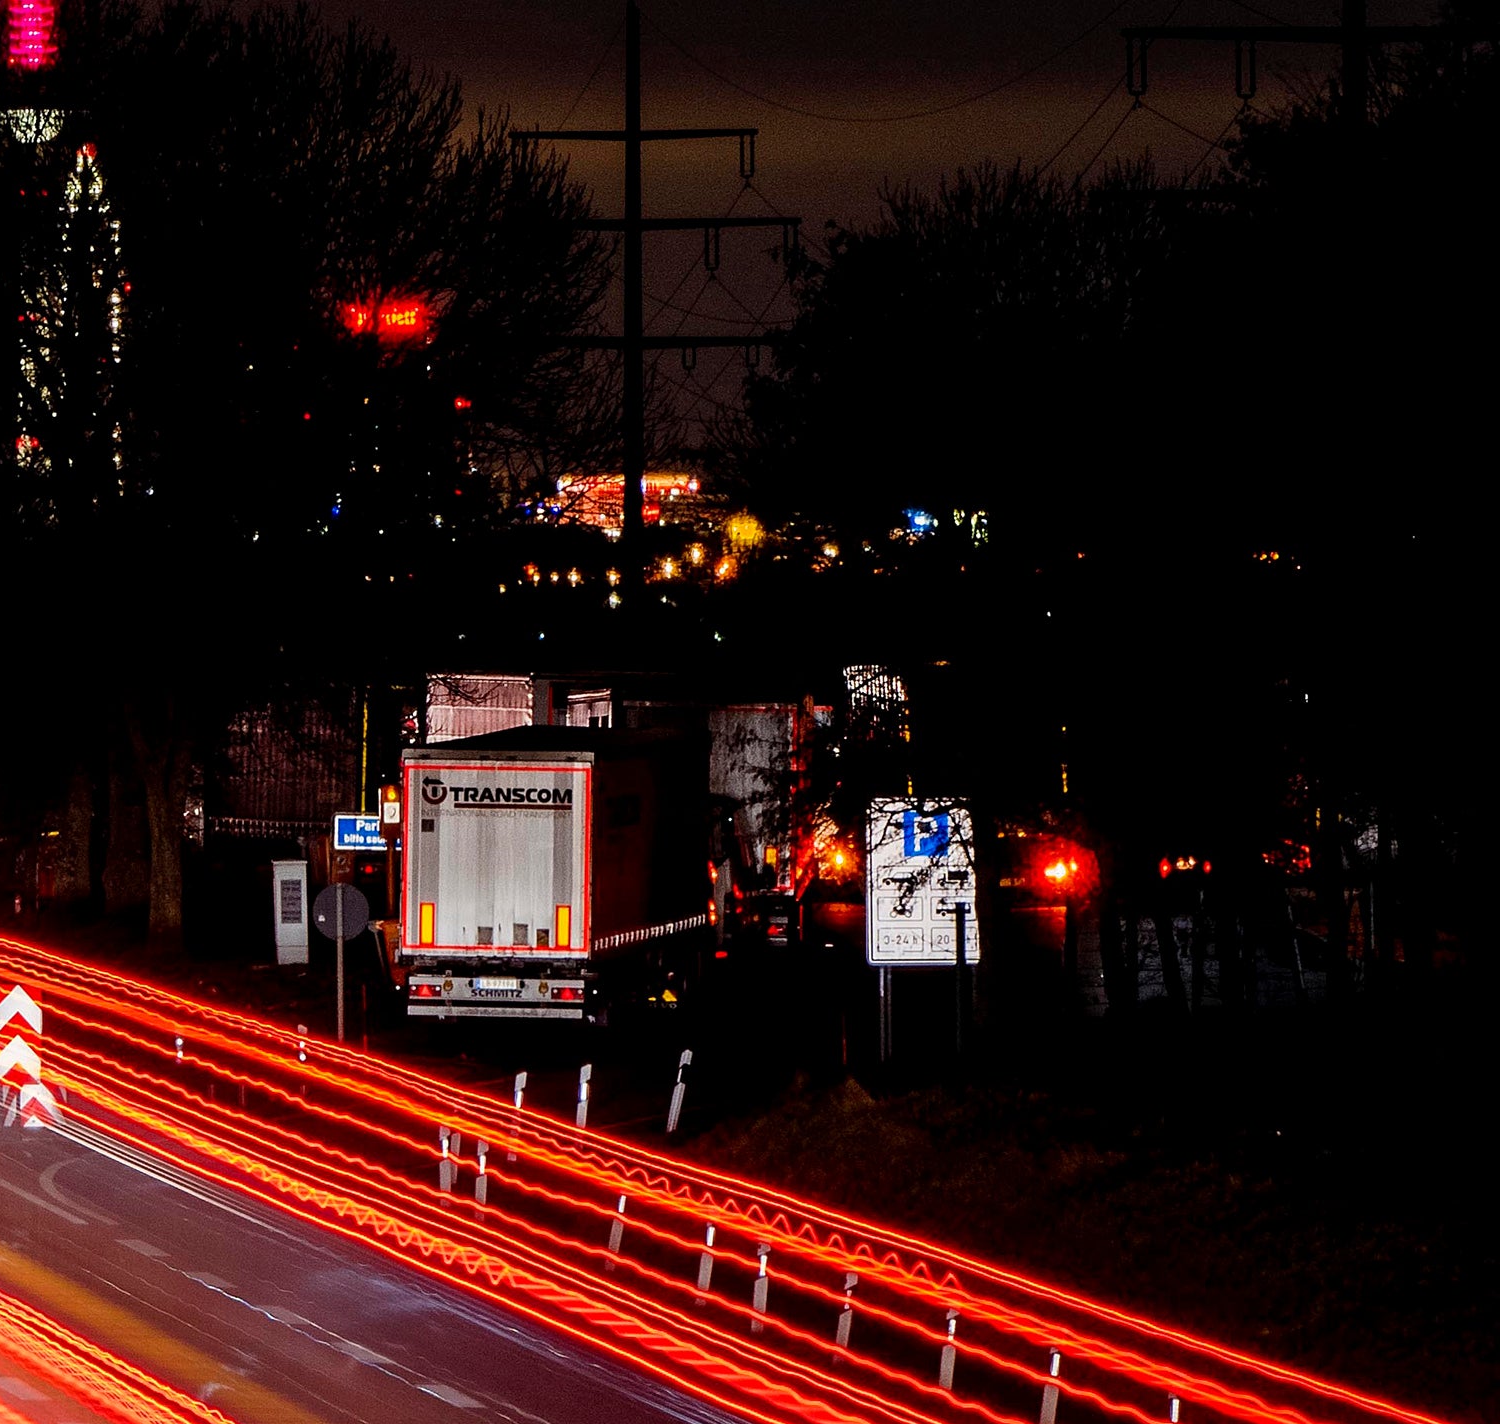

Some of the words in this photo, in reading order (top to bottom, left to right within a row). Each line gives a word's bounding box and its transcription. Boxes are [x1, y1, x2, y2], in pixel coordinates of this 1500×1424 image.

[449, 787, 573, 804] TRANSCOM
[422, 809, 487, 817] INTERNATIONAL
[490, 810, 516, 818] ROAD
[471, 988, 523, 998] SCHMITZ
